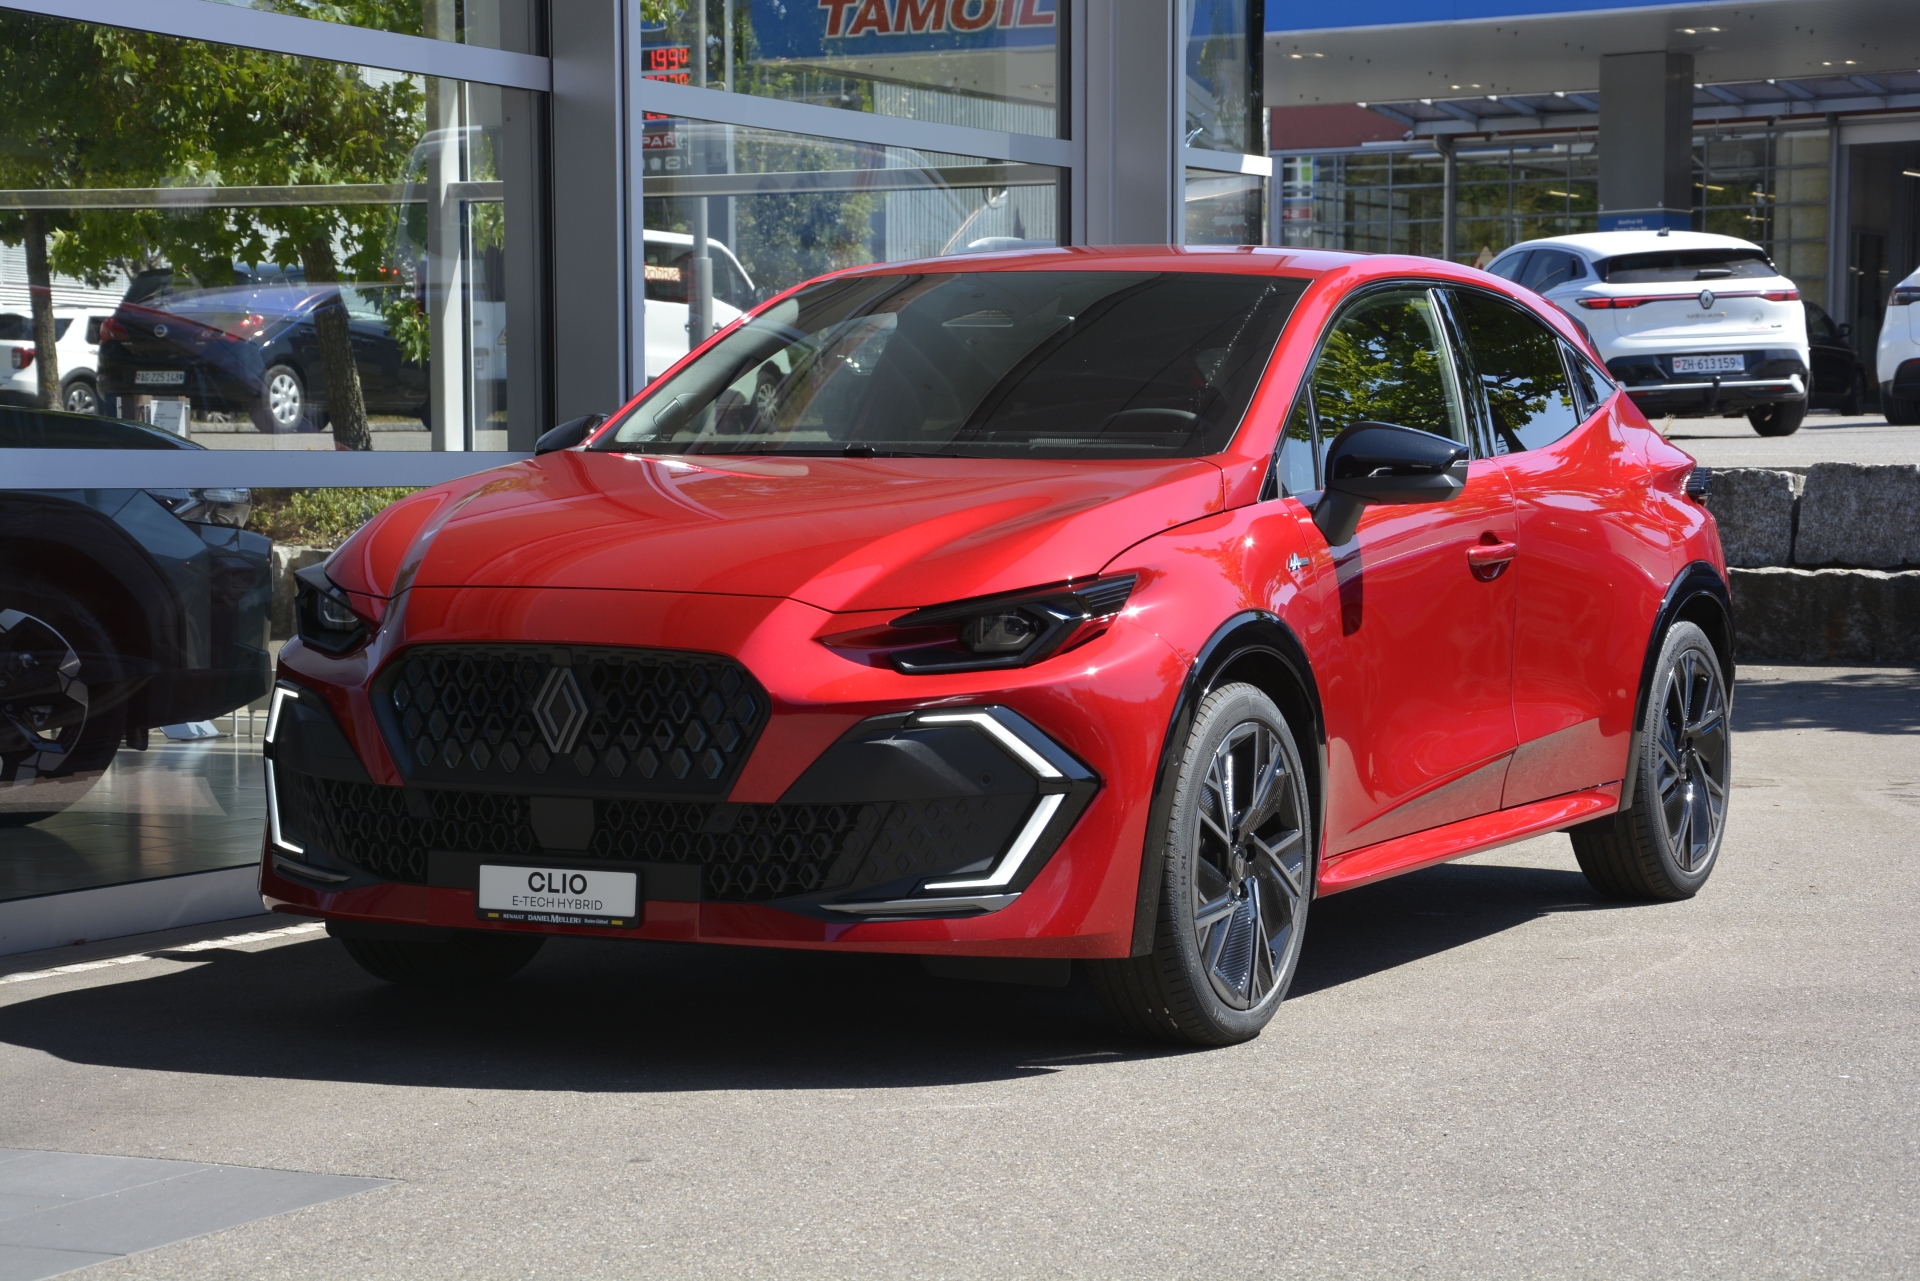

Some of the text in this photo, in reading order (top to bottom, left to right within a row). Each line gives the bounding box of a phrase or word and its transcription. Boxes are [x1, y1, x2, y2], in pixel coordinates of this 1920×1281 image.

[817, 0, 1056, 38] TAMOIL
[643, 135, 676, 147] PAR
[528, 871, 588, 895] CLIO
[512, 895, 603, 911] E-TECH HYBRID
